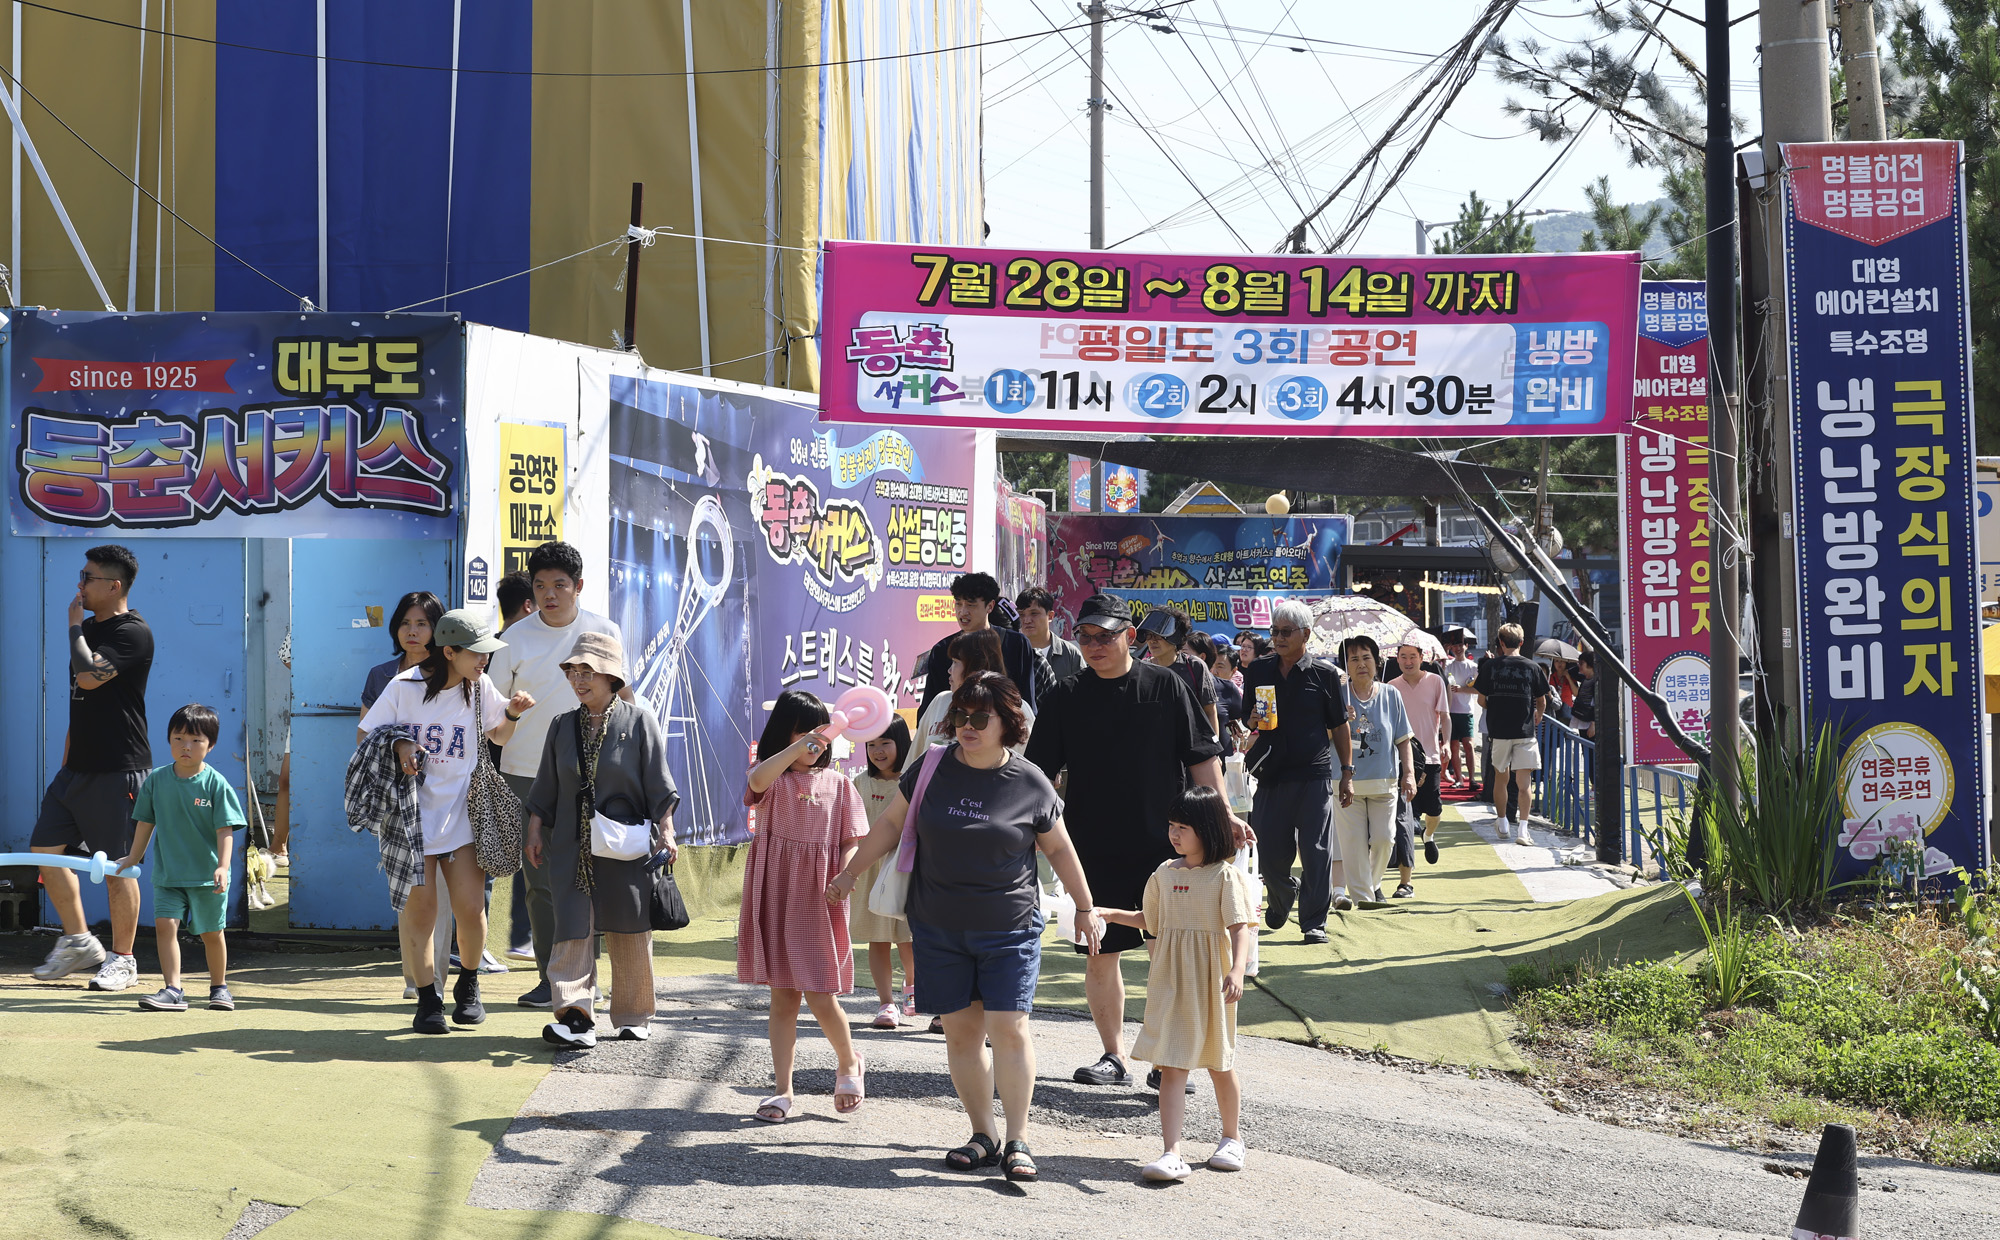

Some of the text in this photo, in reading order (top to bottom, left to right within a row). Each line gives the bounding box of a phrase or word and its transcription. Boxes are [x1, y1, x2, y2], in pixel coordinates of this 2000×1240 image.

[1821, 153, 1923, 184] 명불허전
[1823, 187, 1925, 218] 명품공연
[912, 253, 994, 307] 7월
[1005, 259, 1128, 311] 28일
[1202, 265, 1289, 316] 8월
[1300, 265, 1411, 317] 14일
[1424, 270, 1518, 315] 까지
[1851, 257, 1900, 283] 대형
[1815, 287, 1939, 315] 에어컨설치
[846, 322, 954, 377] 동춘
[1078, 325, 1215, 363] 평일도
[1232, 328, 1309, 365] 3회
[1328, 329, 1418, 366] 공연
[1527, 329, 1597, 365] 냉방
[1829, 328, 1928, 356] 특수조명
[69, 366, 197, 388] since 1925
[276, 341, 421, 394] 대부도
[1659, 354, 1696, 374] 대형
[873, 373, 965, 409] 서커스
[990, 373, 1028, 406] 1회
[1040, 371, 1111, 412] 11시
[1143, 378, 1188, 410] 2회
[1198, 373, 1256, 414] 2시
[1281, 381, 1323, 412] 3회
[1336, 375, 1394, 416] 4시
[1405, 375, 1495, 416] 30분
[1525, 376, 1594, 413] 완비
[1634, 377, 1709, 397] 에어컨설
[25, 404, 447, 521] 동춘서커스
[790, 437, 828, 470] 98년 전통
[839, 435, 914, 482] 명불허전! 명품공연!
[508, 454, 558, 494] 공연장
[509, 506, 557, 541] 매표소
[762, 483, 814, 556] 동춘
[807, 506, 874, 578] 서커스
[887, 504, 968, 568] 상설공연중
[1086, 541, 1117, 550] Since 1925
[1638, 434, 1681, 638] 냉난방완비
[1817, 377, 1885, 700] 냉난방완비
[1892, 379, 1958, 697] 극장식의자
[1213, 551, 1234, 563] 초대형
[1235, 549, 1274, 560] 아트서커스로
[470, 578, 486, 596] 1426
[1204, 565, 1309, 589] 상설공연중
[1208, 601, 1229, 622] 까지
[1231, 597, 1272, 628] 평일
[781, 627, 874, 688] 스트레스를
[1665, 674, 1710, 688] 연중무휴
[1665, 689, 1710, 702] 연속공연
[1861, 756, 1931, 779] 연중무휴
[194, 797, 213, 808] REA
[960, 797, 983, 809] C'est
[1862, 780, 1931, 802] 연속공연
[948, 806, 990, 821] Très bien
